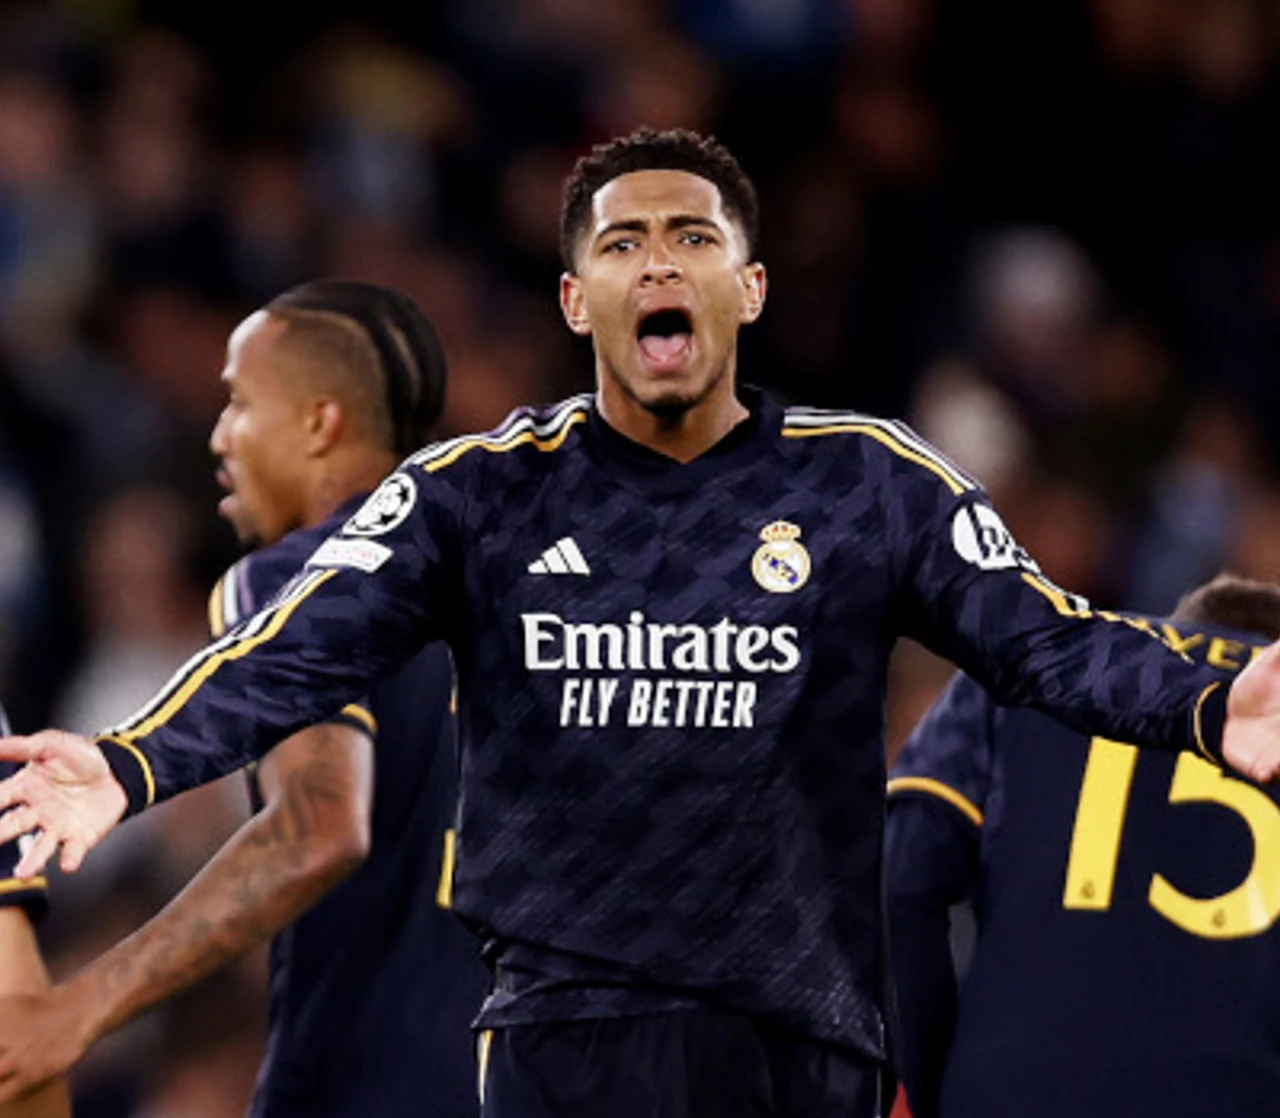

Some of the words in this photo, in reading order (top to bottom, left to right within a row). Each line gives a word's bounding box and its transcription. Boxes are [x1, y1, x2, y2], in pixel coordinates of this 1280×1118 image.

[520, 611, 801, 672] Emirates
[559, 678, 619, 728] FLY
[627, 680, 757, 728] BETTER
